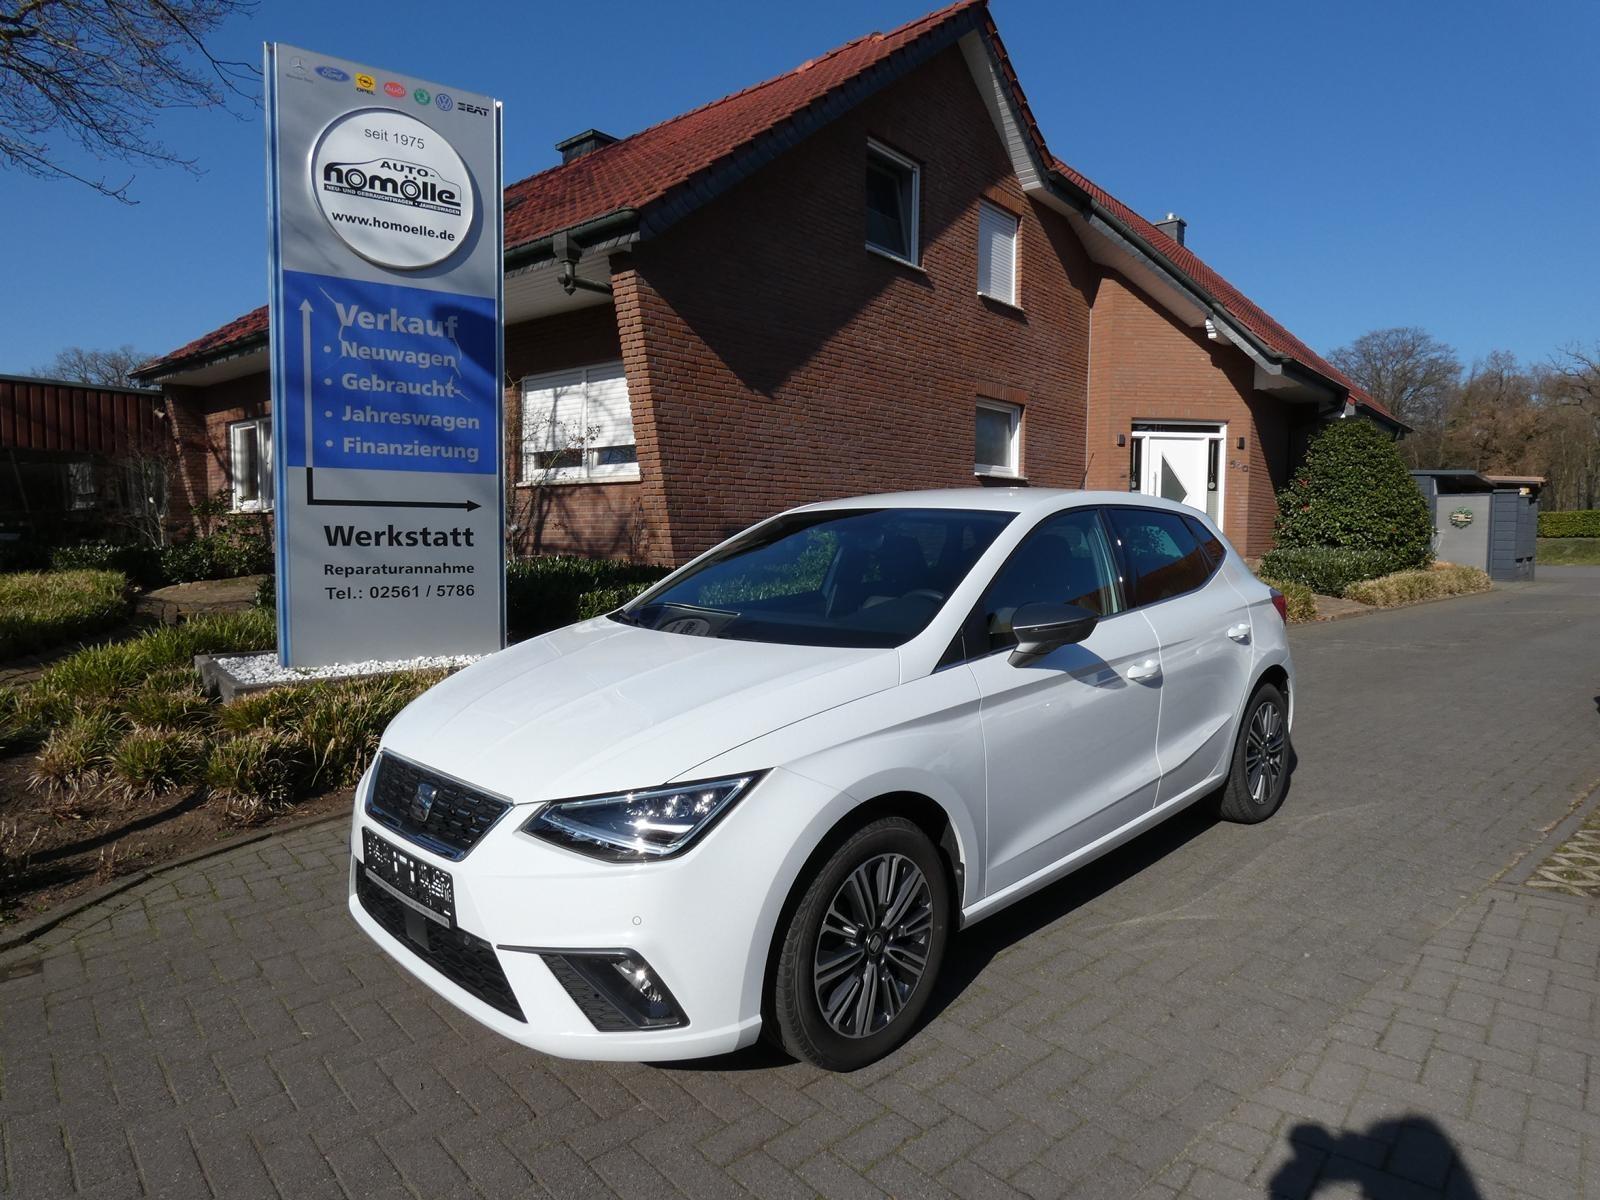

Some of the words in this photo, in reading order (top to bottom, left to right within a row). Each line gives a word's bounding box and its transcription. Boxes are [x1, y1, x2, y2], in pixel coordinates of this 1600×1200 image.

[458, 102, 490, 117] SEAT
[364, 128, 388, 143] seit
[393, 133, 425, 150] 1975
[324, 162, 461, 208] homölle
[343, 187, 357, 195] UND
[357, 190, 414, 206] GEBRAUCHTWAGEN
[419, 202, 460, 215] JAHRESWAGEN
[332, 211, 455, 242] www.homoelle.de
[335, 303, 458, 339] Verkauf
[340, 341, 456, 369] Neuwagen
[342, 405, 480, 431] Jahreswagen
[343, 437, 479, 462] Finanzierung
[324, 525, 475, 547] Werkstatt
[324, 563, 475, 578] Reparaturannahme
[325, 587, 362, 600] Tel.:
[369, 585, 419, 599] 02561
[436, 584, 475, 597] 5786
